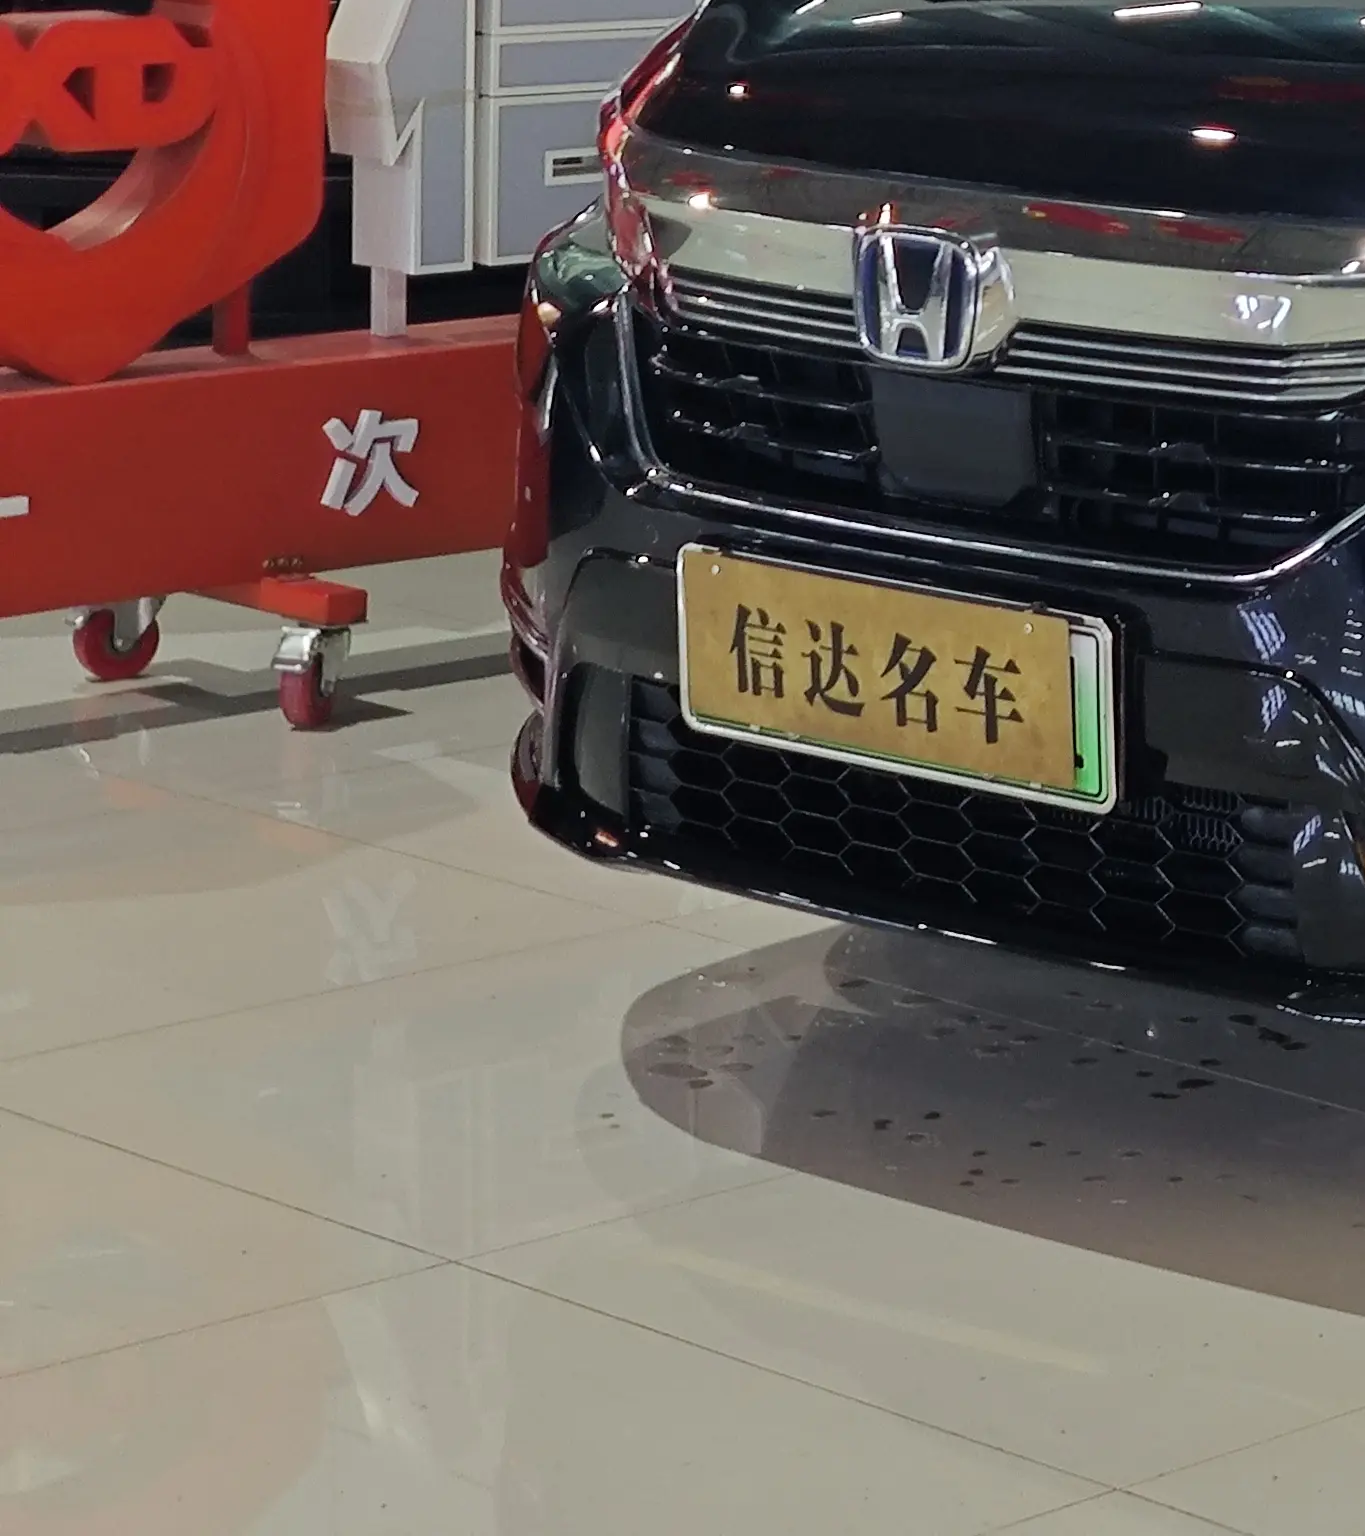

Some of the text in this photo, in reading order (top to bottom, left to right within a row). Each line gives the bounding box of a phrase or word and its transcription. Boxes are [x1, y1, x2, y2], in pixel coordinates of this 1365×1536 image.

[322, 409, 420, 518] 次
[729, 603, 1026, 745] 信达名车
